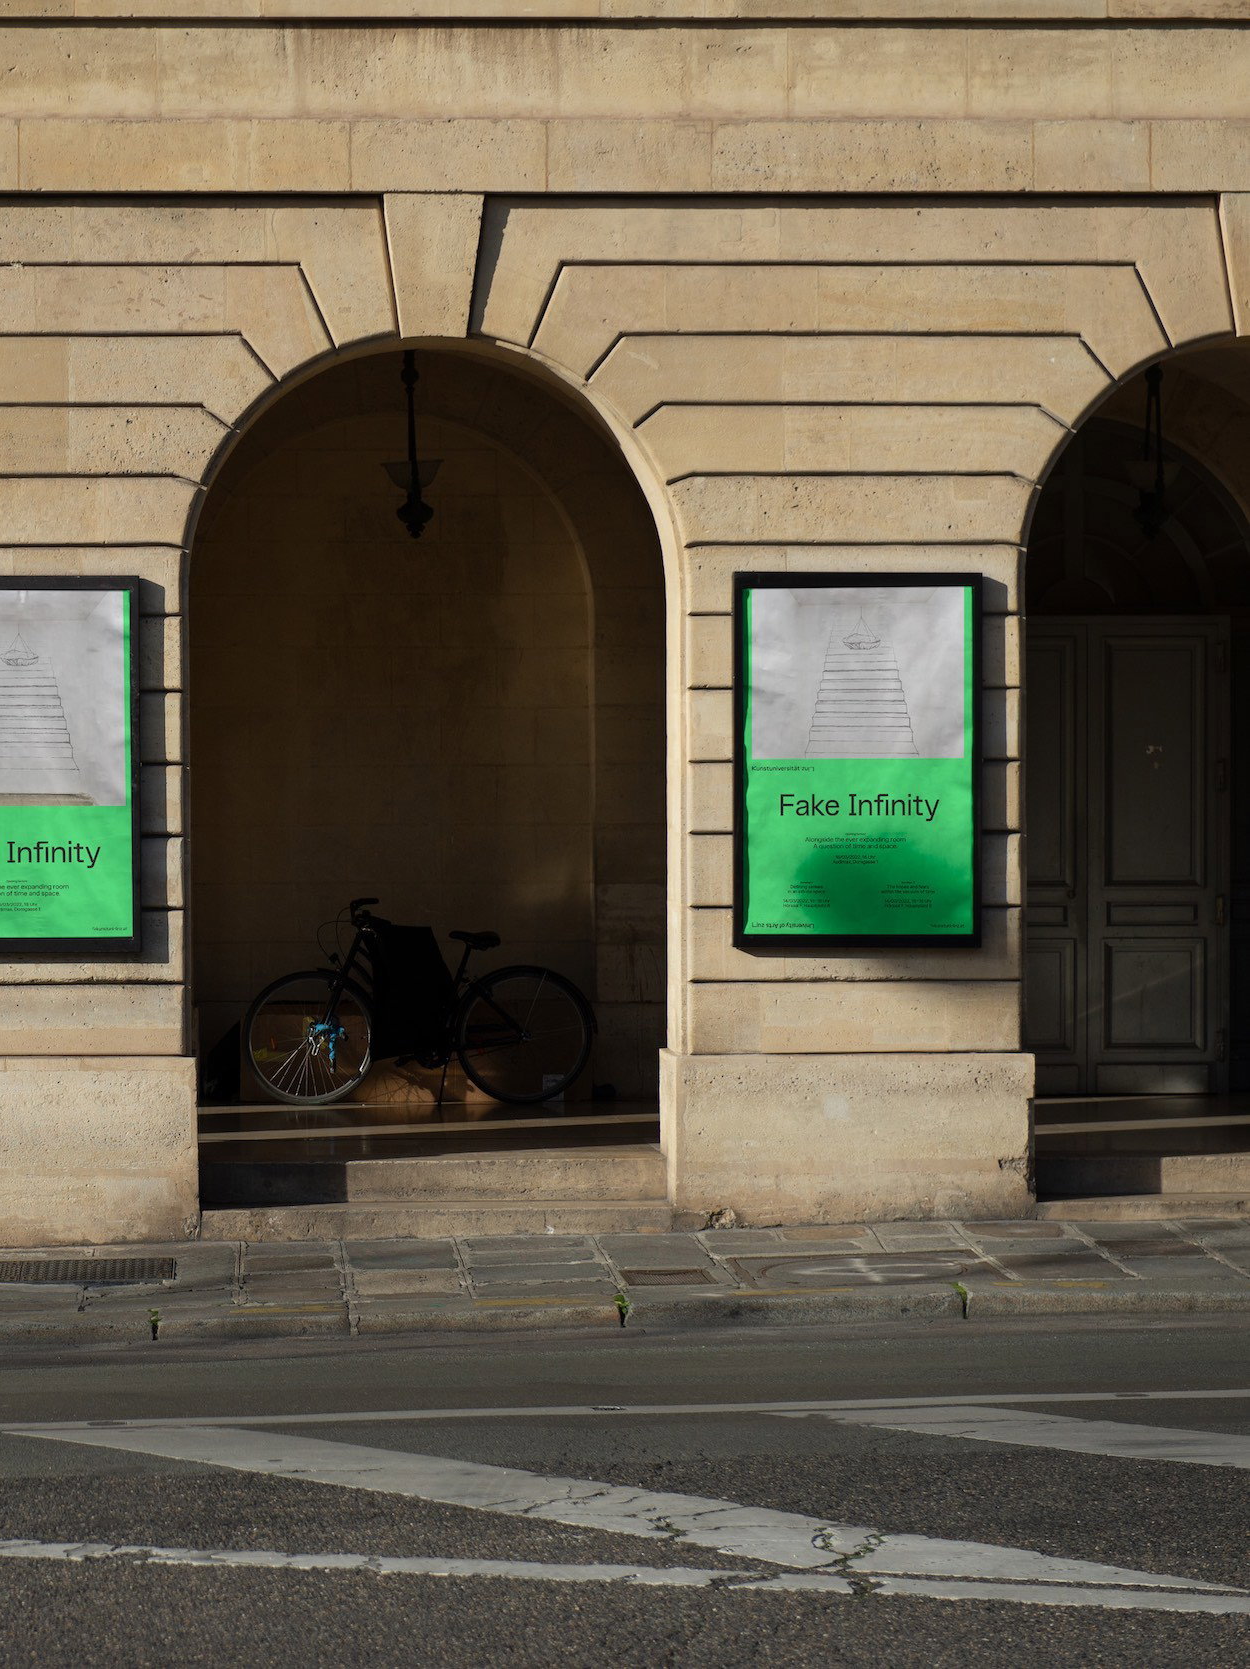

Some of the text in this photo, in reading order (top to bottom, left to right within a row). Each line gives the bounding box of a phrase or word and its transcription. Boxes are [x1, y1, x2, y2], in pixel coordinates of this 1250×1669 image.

[779, 793, 940, 822] Fake Infinity
[6, 840, 102, 868] Infinity
